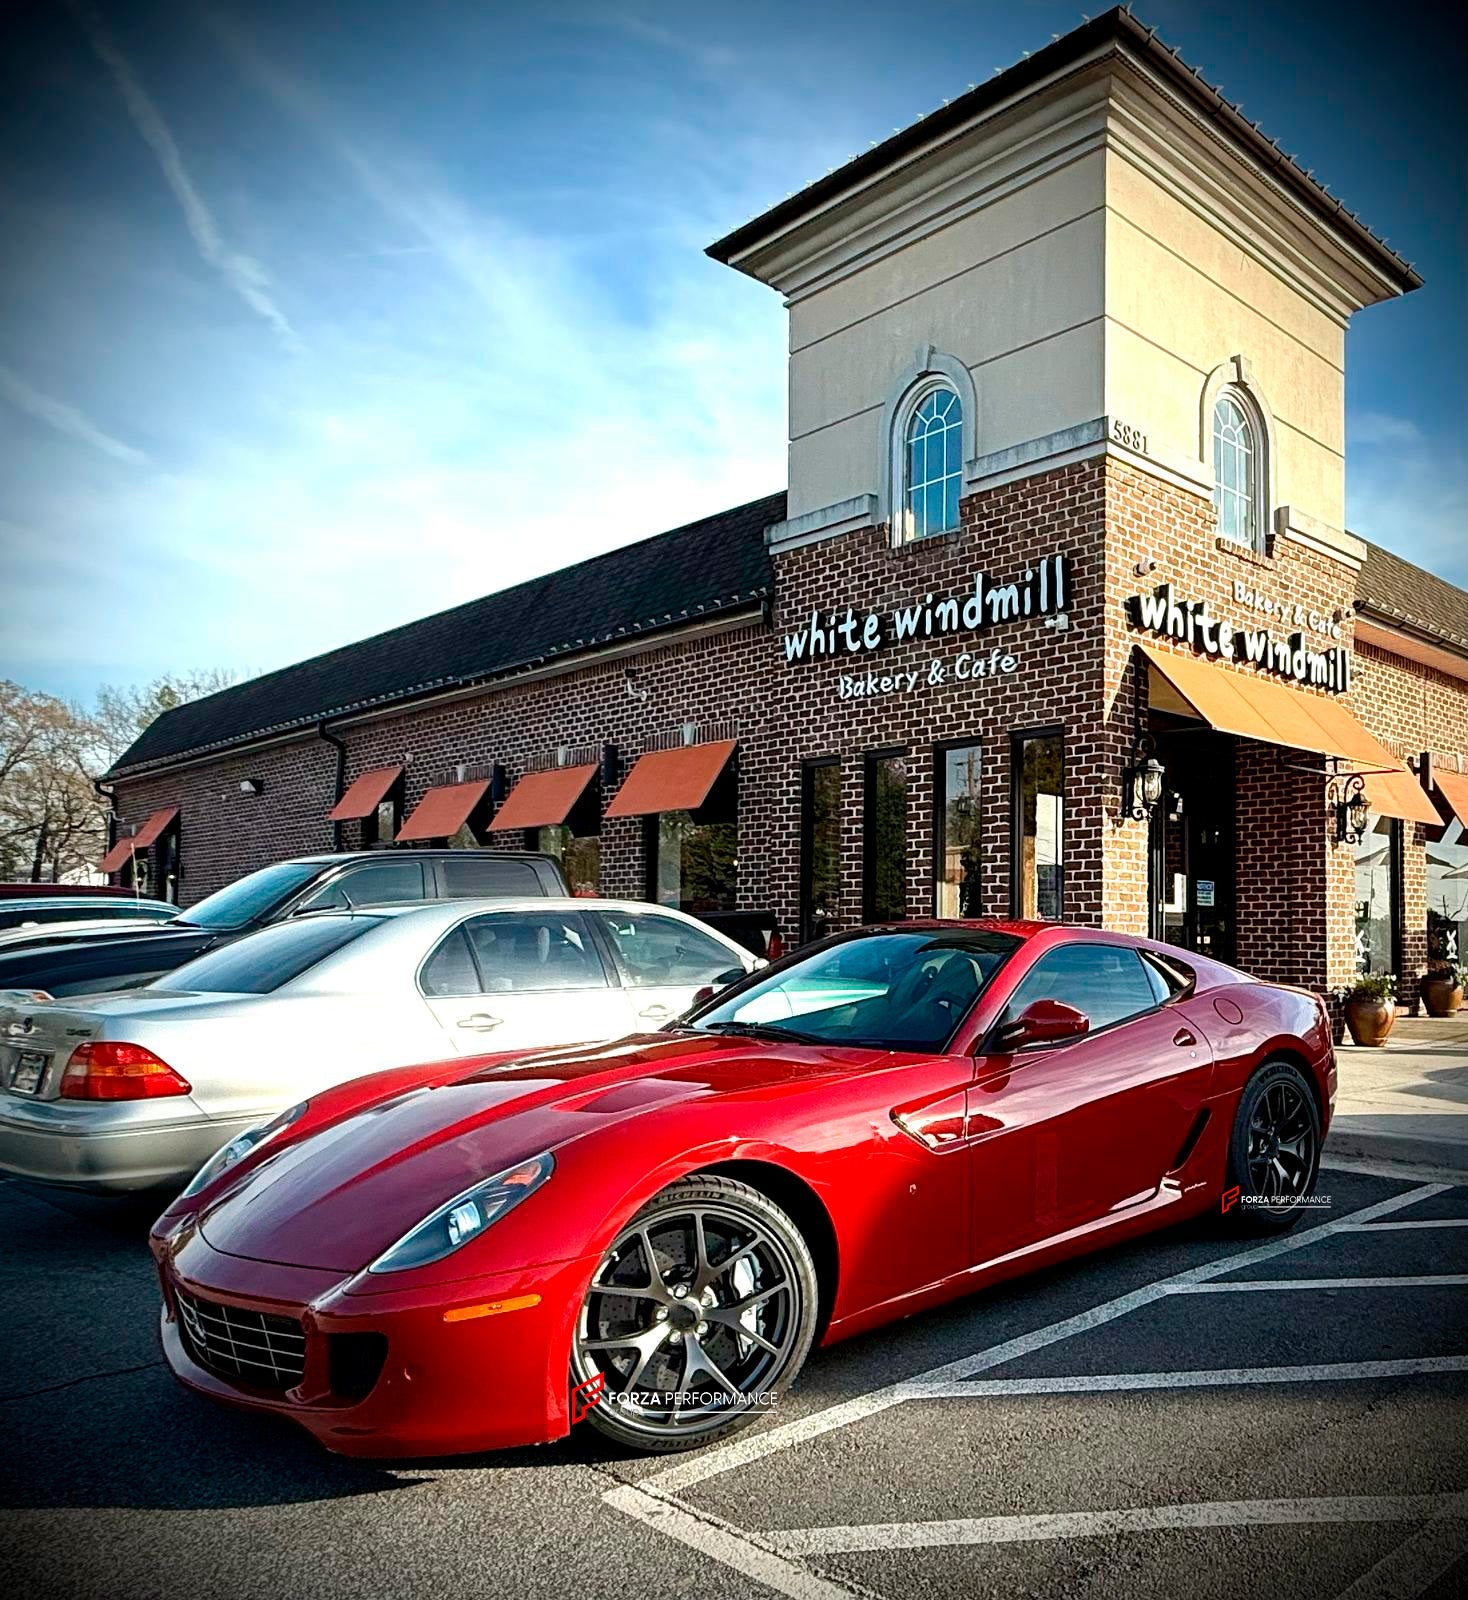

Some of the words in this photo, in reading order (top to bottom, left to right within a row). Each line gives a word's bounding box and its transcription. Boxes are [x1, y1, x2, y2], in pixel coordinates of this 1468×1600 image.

[1113, 420, 1149, 455] 5881
[784, 608, 881, 661] white
[894, 555, 1064, 640] windmill
[1140, 583, 1235, 658] white
[1243, 628, 1350, 691] windmill
[1233, 580, 1290, 623] Bakery
[1293, 604, 1304, 625] &
[1308, 611, 1341, 639] Cafe
[839, 670, 918, 700] Bakery
[928, 659, 945, 685] &
[954, 649, 1018, 680] Cafe
